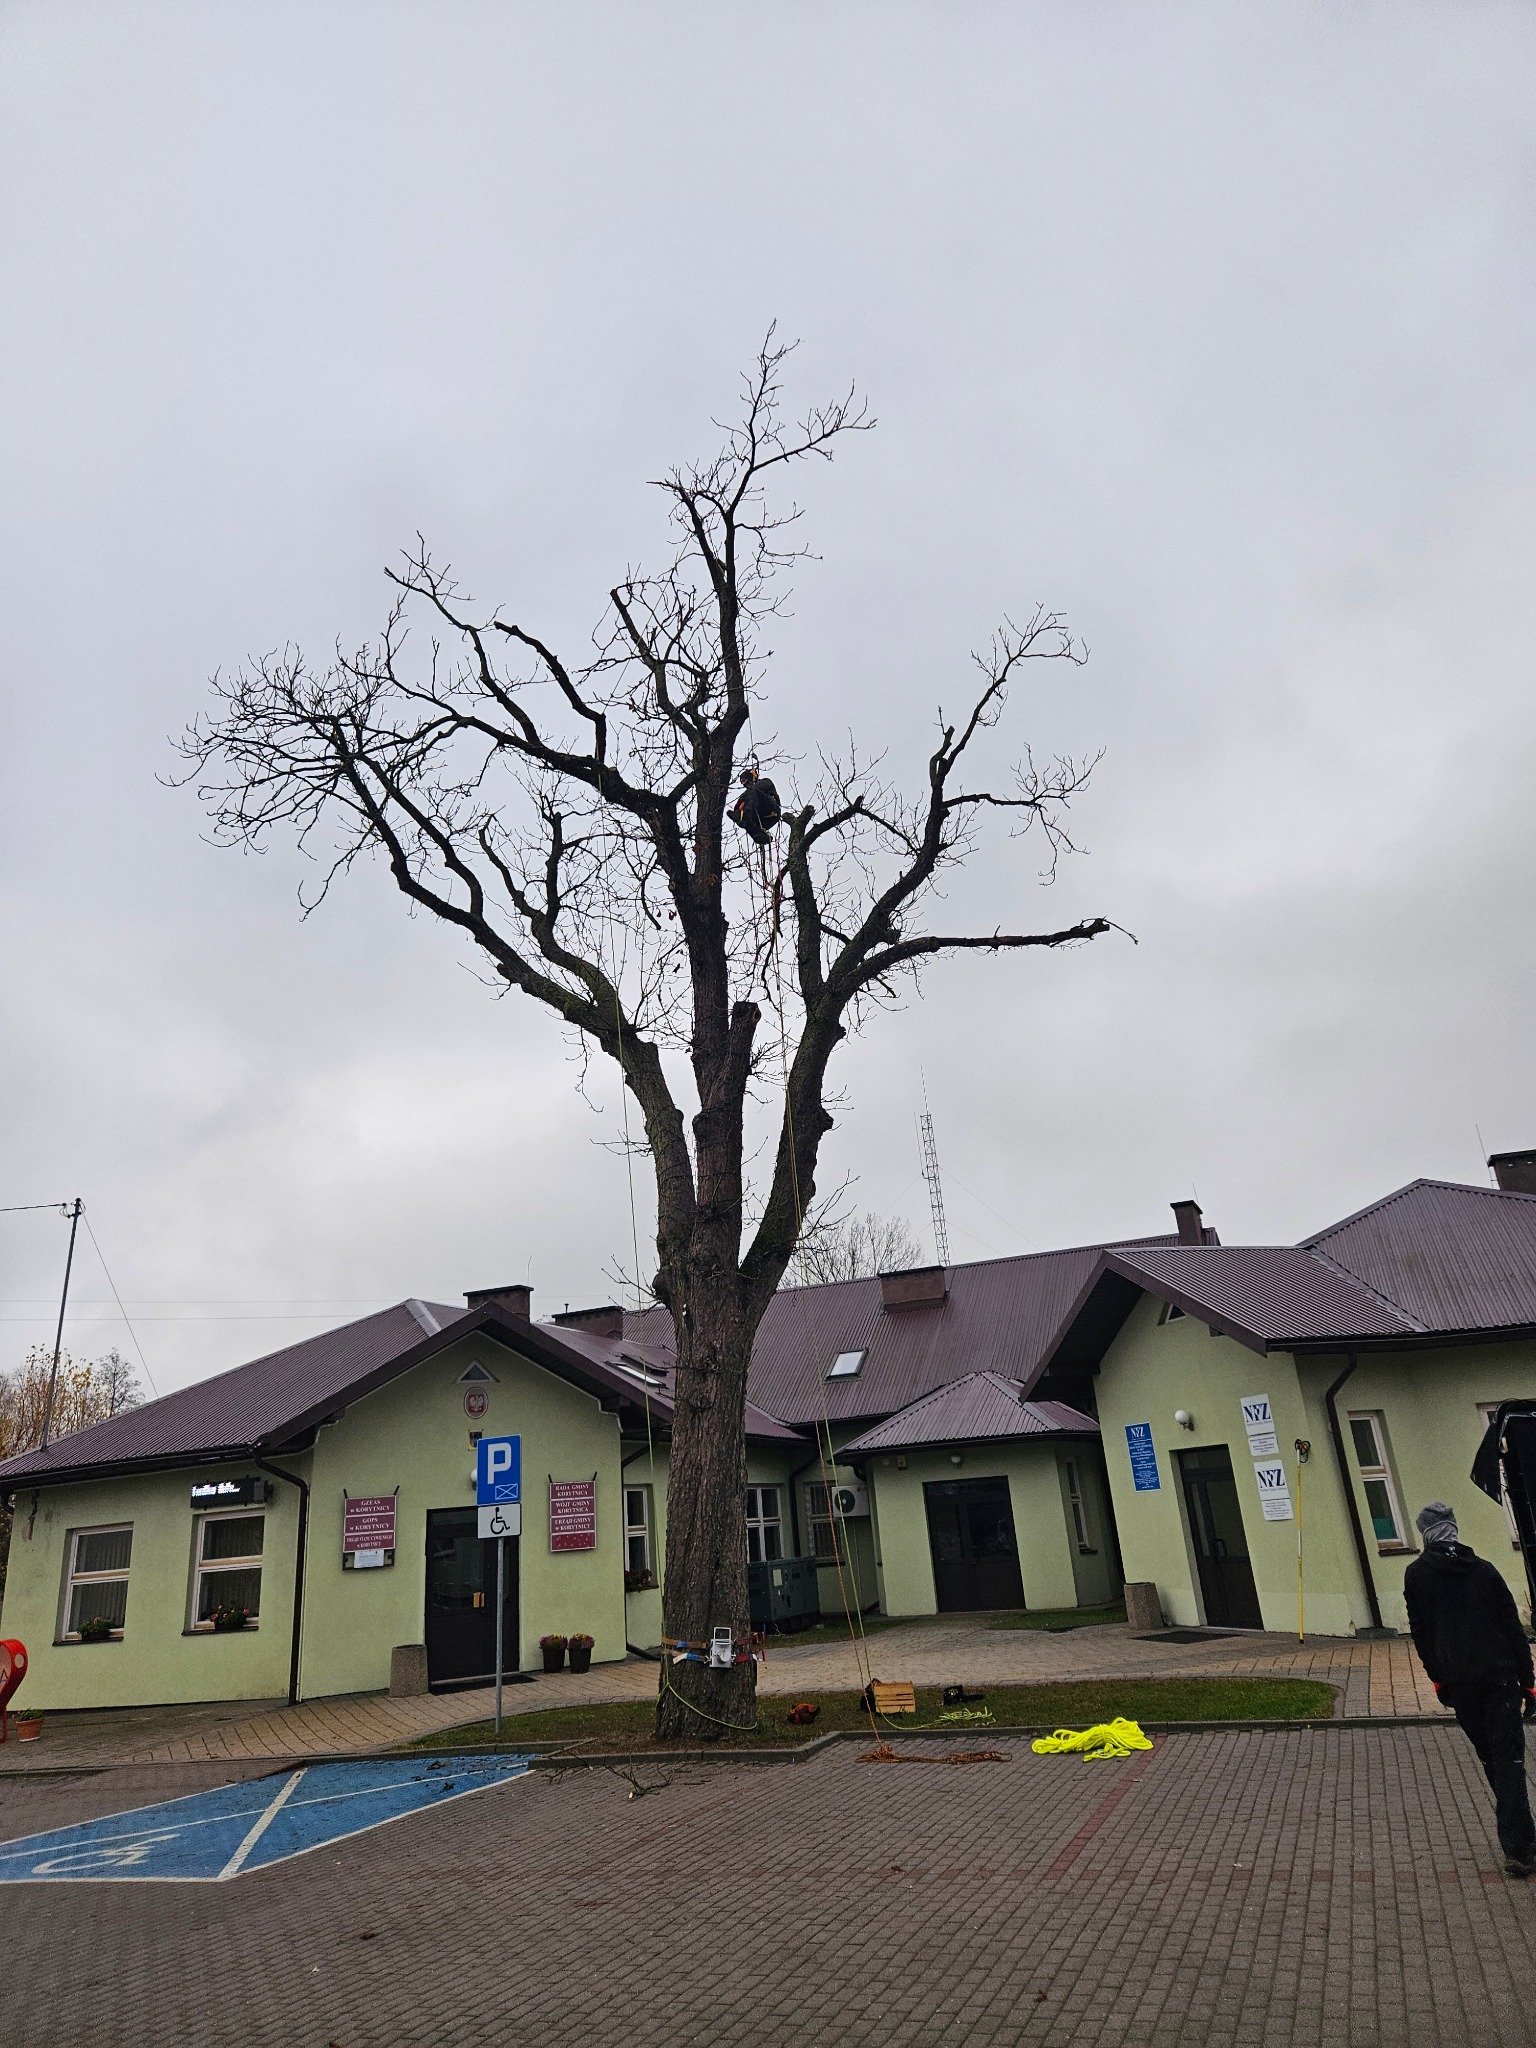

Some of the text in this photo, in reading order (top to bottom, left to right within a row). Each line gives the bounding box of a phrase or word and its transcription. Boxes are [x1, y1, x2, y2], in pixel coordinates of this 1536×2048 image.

[1243, 1403, 1271, 1423] NFZ
[1130, 1426, 1146, 1438] NFZ
[487, 1442, 512, 1485] P
[1257, 1469, 1286, 1488] NFZ
[355, 1505, 390, 1513] KORYTNICY
